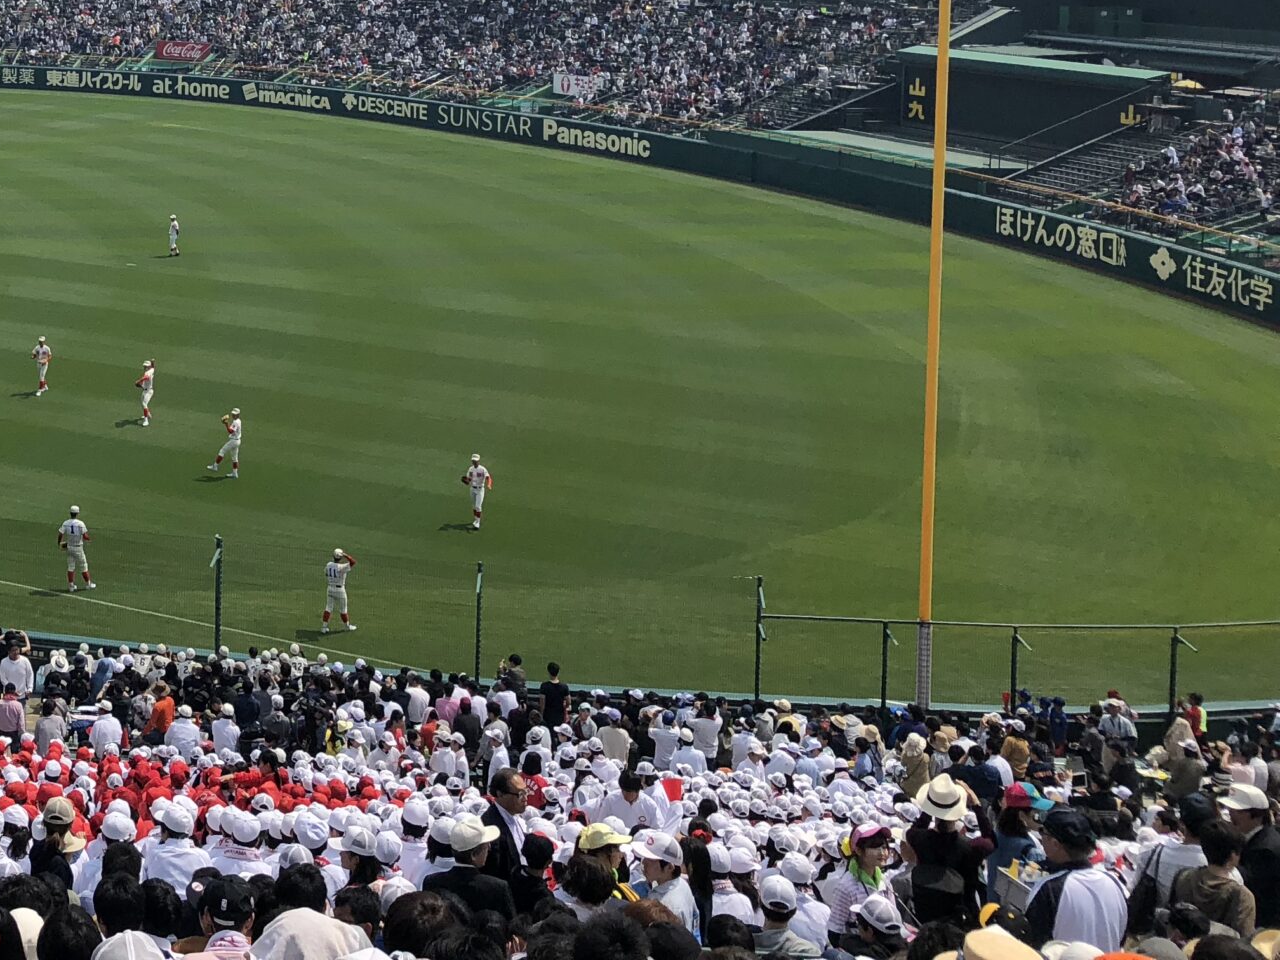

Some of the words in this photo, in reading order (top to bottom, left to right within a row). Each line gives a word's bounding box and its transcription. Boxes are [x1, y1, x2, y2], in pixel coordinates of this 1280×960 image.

[46, 70, 142, 91] 東進ハイスクール
[152, 78, 173, 95] at
[175, 76, 230, 100] home
[358, 97, 428, 120] DESCENTE
[437, 104, 532, 137] SUNSTAR
[543, 119, 650, 158] Panasonic
[1182, 254, 1273, 311] 住友化学
